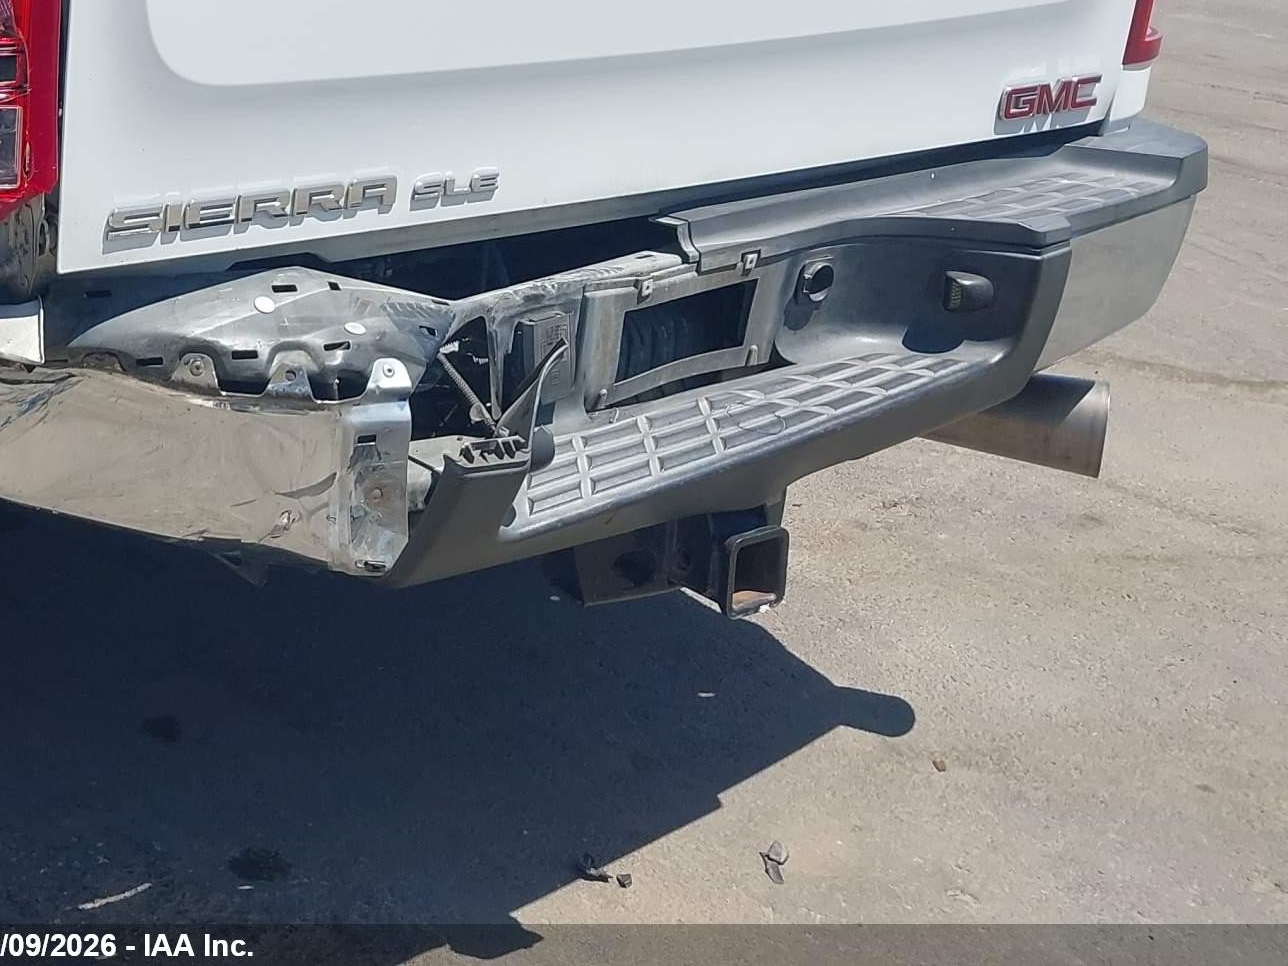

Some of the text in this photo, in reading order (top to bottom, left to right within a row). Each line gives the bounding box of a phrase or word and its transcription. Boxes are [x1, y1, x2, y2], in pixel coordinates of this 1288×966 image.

[999, 74, 1103, 121] GMC
[106, 168, 500, 241] SIERRA SLE
